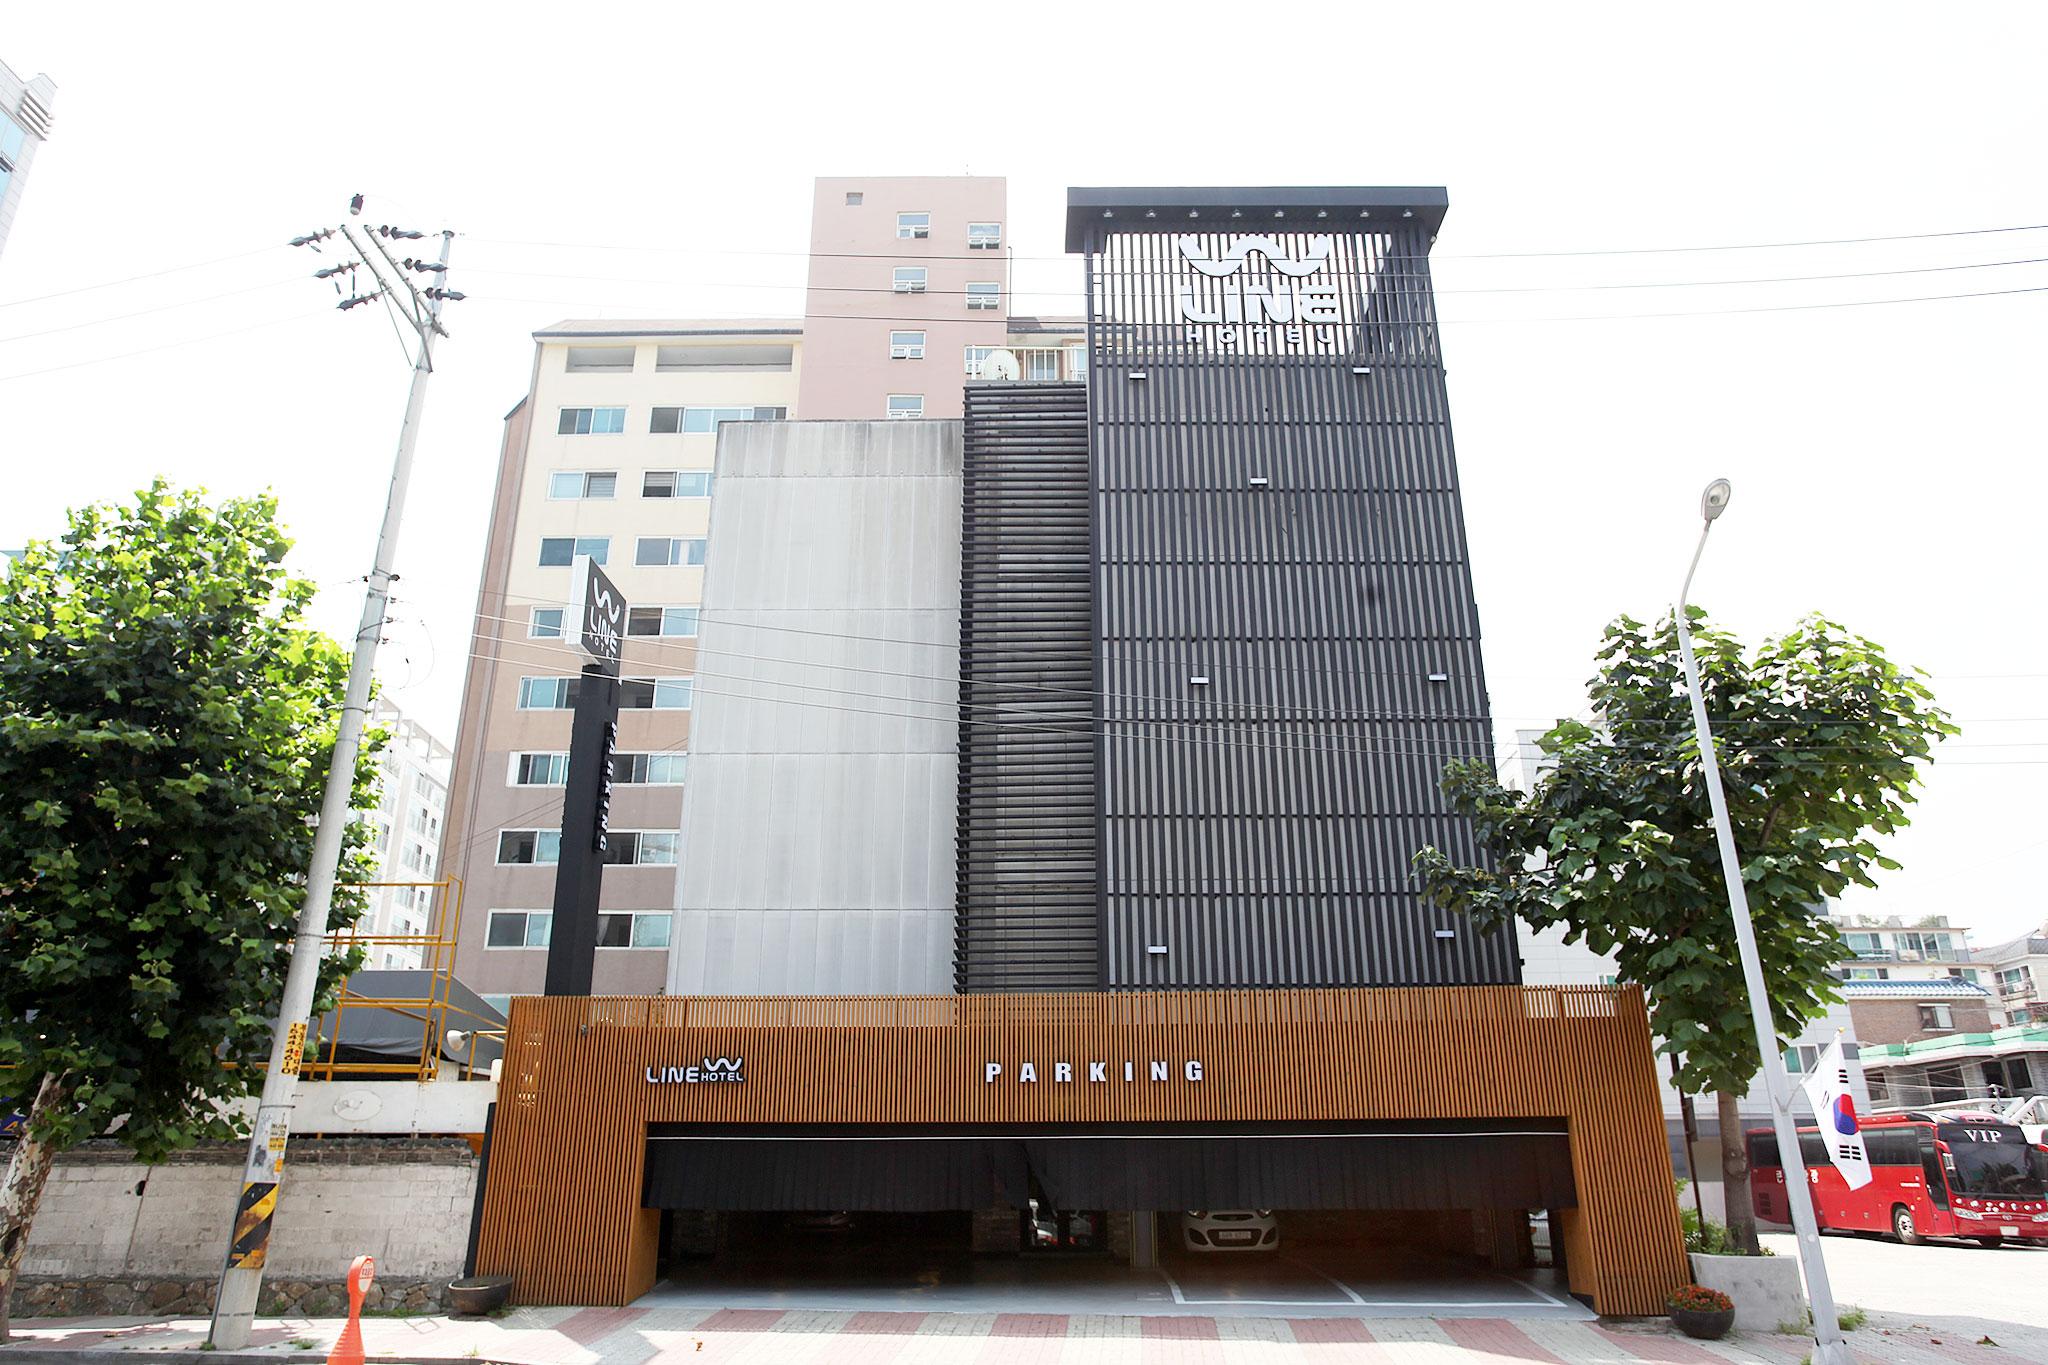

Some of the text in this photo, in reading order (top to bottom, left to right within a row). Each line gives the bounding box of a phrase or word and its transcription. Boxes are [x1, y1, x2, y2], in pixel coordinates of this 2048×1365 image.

[1181, 284, 1339, 323] LINE
[1186, 328, 1332, 344] HOTEL
[591, 605, 618, 655] LINE
[589, 629, 615, 664] HOTEL
[600, 721, 617, 851] PARKING
[646, 1066, 744, 1083] LINE HOTEL
[985, 1060, 1203, 1083] PARKING
[1963, 1129, 2002, 1143] VIP
